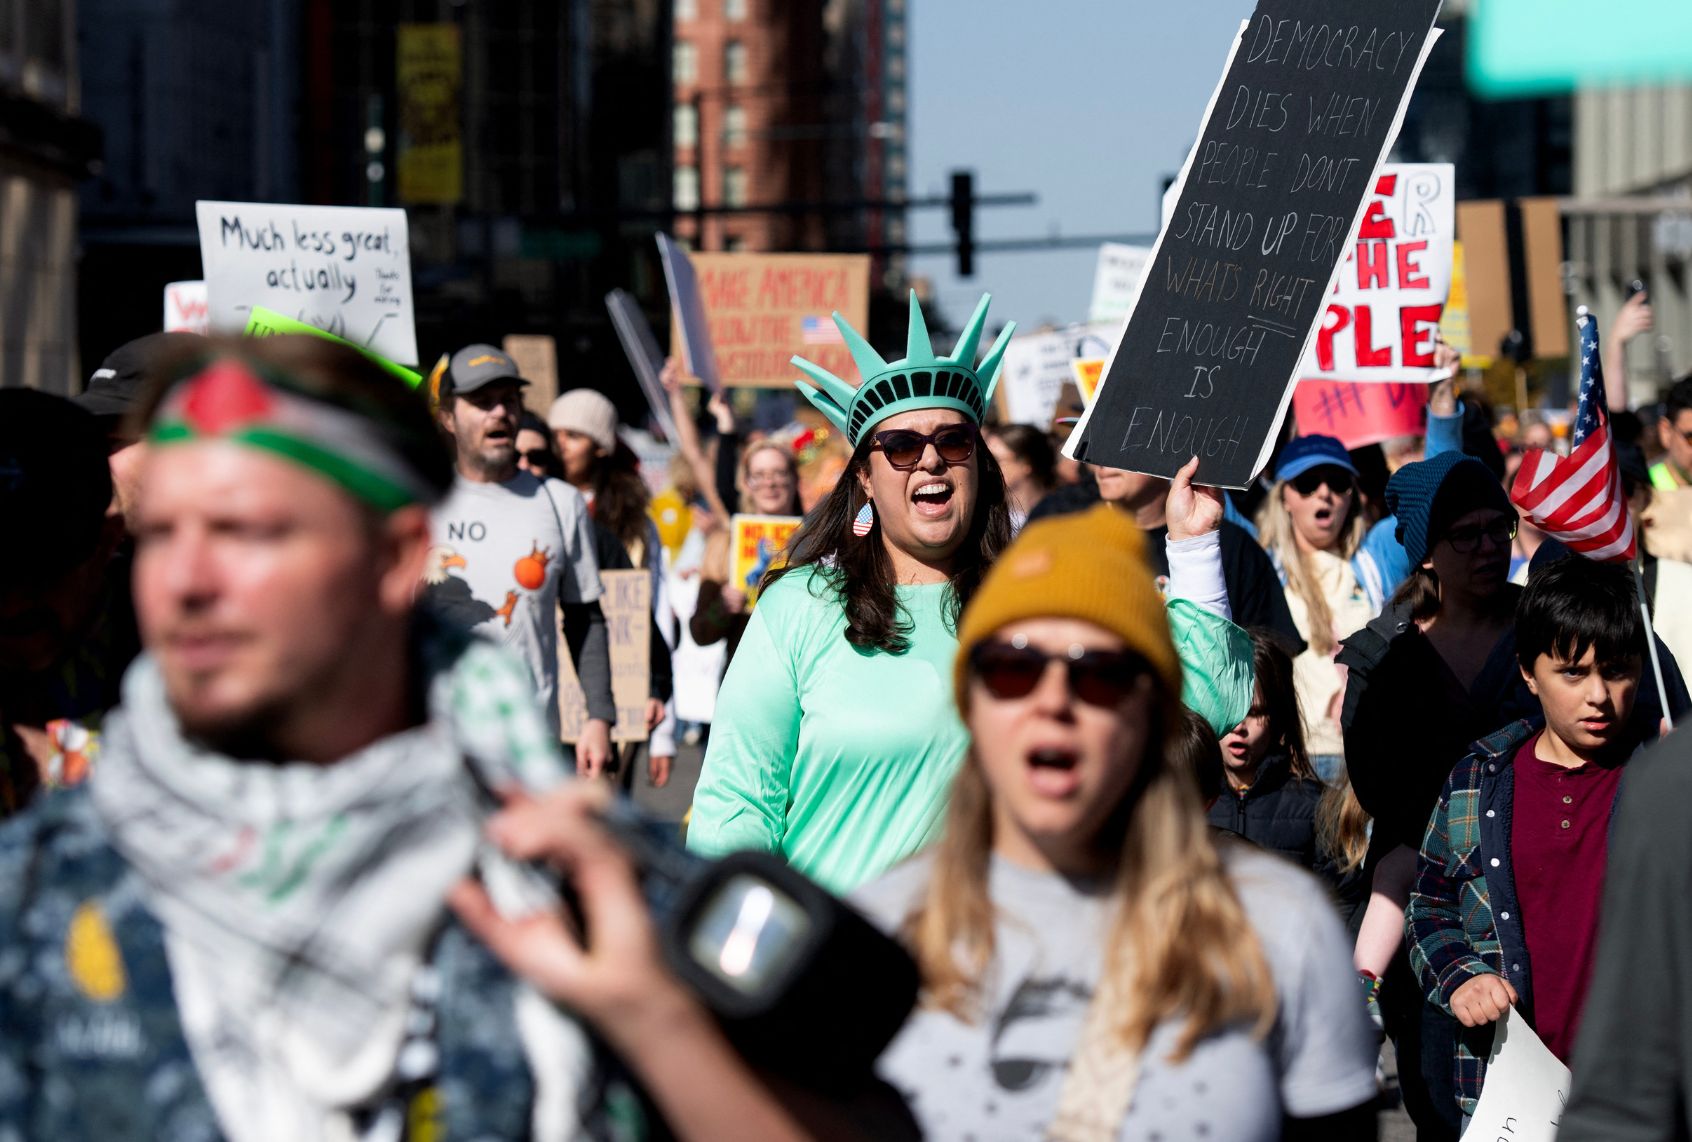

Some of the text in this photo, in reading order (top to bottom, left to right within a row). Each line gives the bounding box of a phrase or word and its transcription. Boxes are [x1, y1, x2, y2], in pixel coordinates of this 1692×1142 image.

[1247, 15, 1414, 75] DEMOCRACY
[1226, 85, 1380, 137] DIES WHEN
[1198, 140, 1360, 194] PEOPLE DON'T
[221, 215, 285, 251] Much
[292, 219, 336, 255] less
[1175, 201, 1344, 267] STAND UP FOR
[267, 260, 357, 305] actually
[1249, 268, 1315, 320] RIGHT
[1157, 317, 1266, 366] ENOUGH
[1316, 304, 1443, 371] PLE
[1183, 365, 1220, 399] IS
[1120, 407, 1249, 464] ENOUGH
[448, 521, 487, 542] NO
